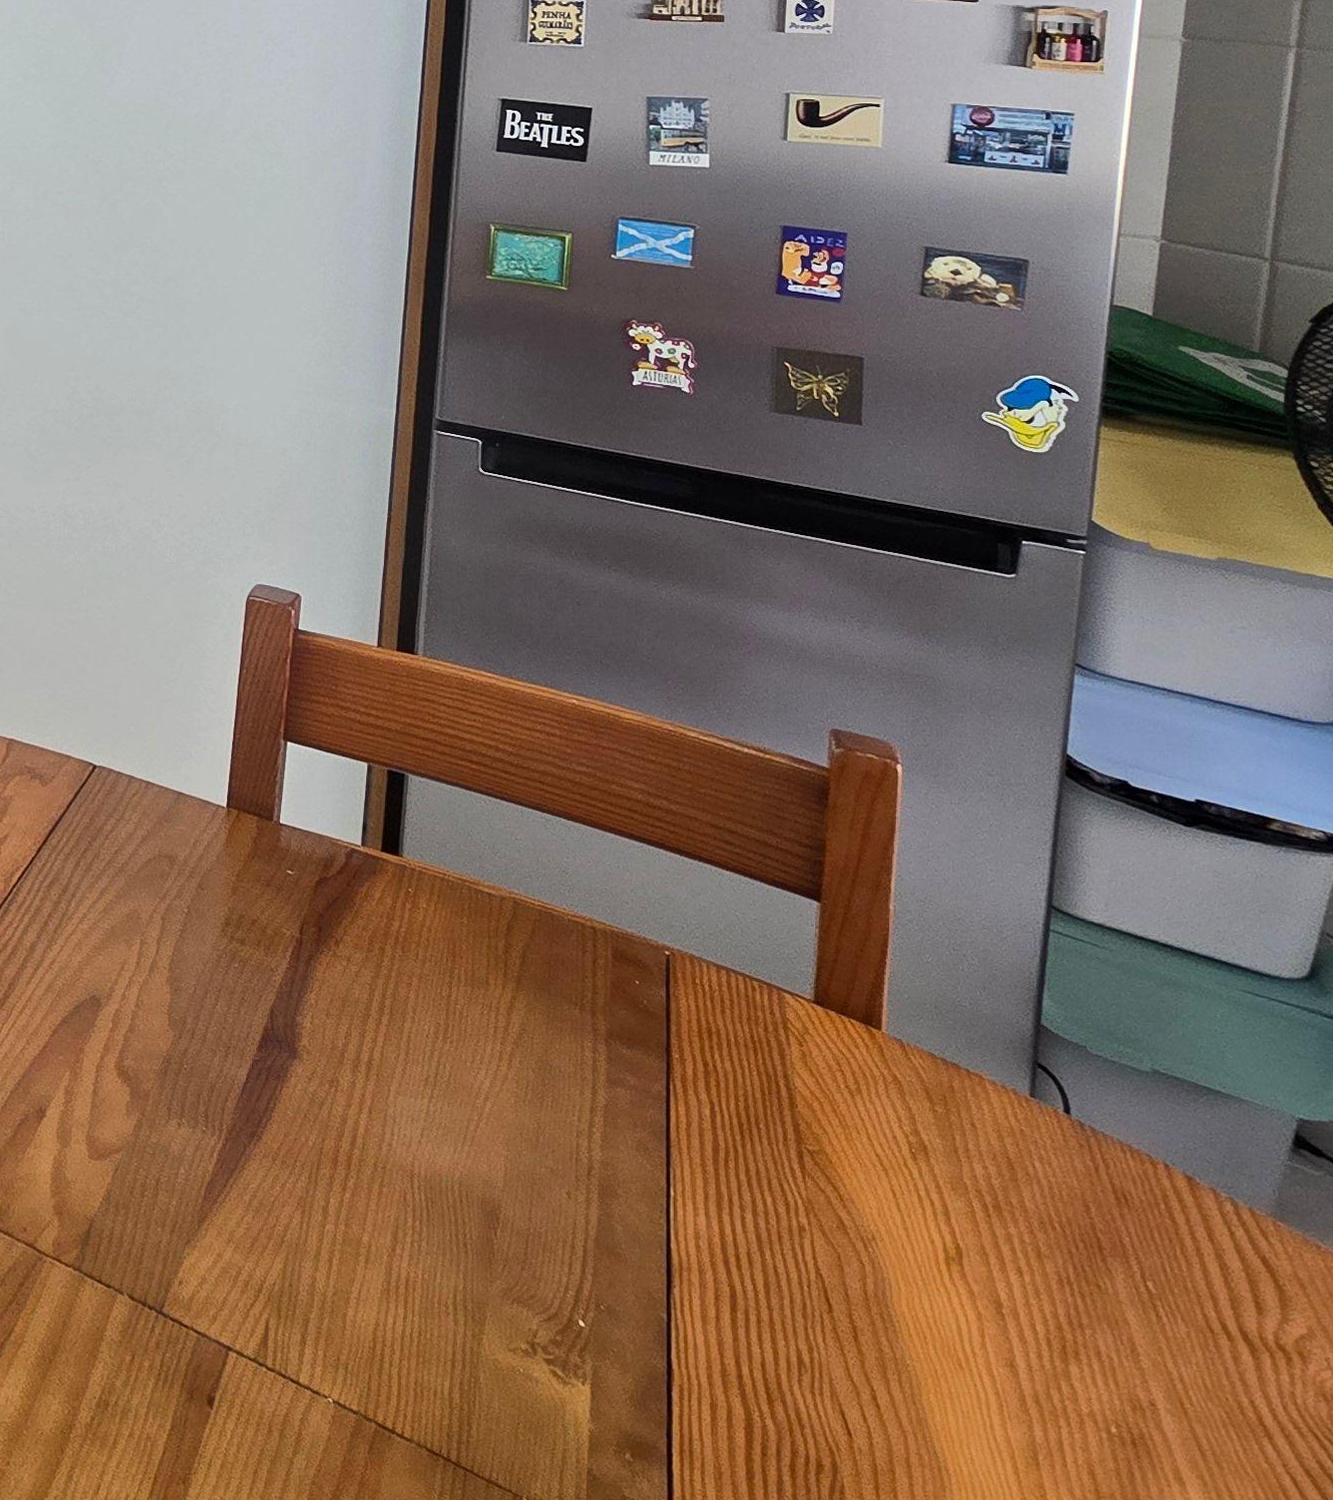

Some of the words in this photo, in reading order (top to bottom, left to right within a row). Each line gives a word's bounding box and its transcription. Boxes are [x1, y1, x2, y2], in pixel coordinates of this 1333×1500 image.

[536, 111, 554, 122] THE
[503, 109, 585, 148] BEATLES
[658, 154, 700, 164] MILANO
[643, 370, 682, 386] ASTURIAS
